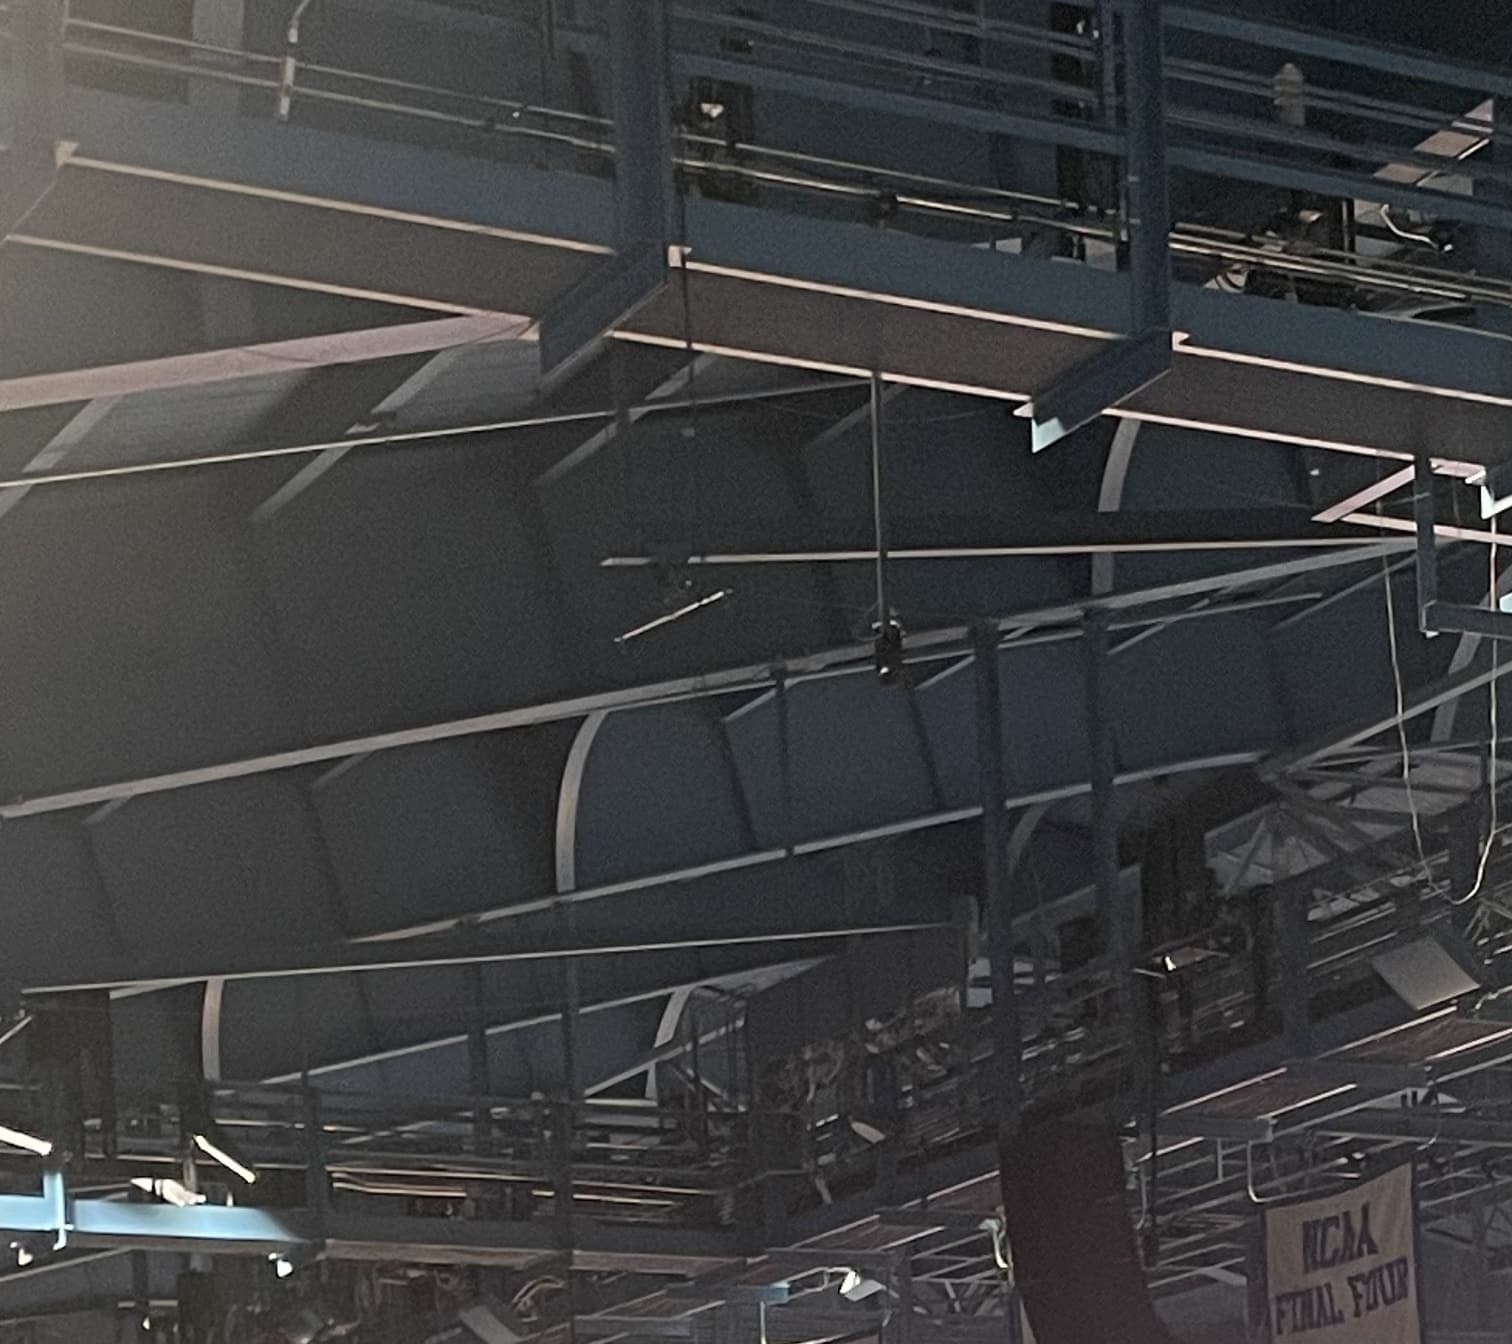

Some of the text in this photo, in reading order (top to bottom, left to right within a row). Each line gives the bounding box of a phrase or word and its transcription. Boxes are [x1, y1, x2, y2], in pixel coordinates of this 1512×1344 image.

[1302, 1204, 1378, 1273] NCAA
[1276, 1257, 1408, 1334] FINAL FOUR
